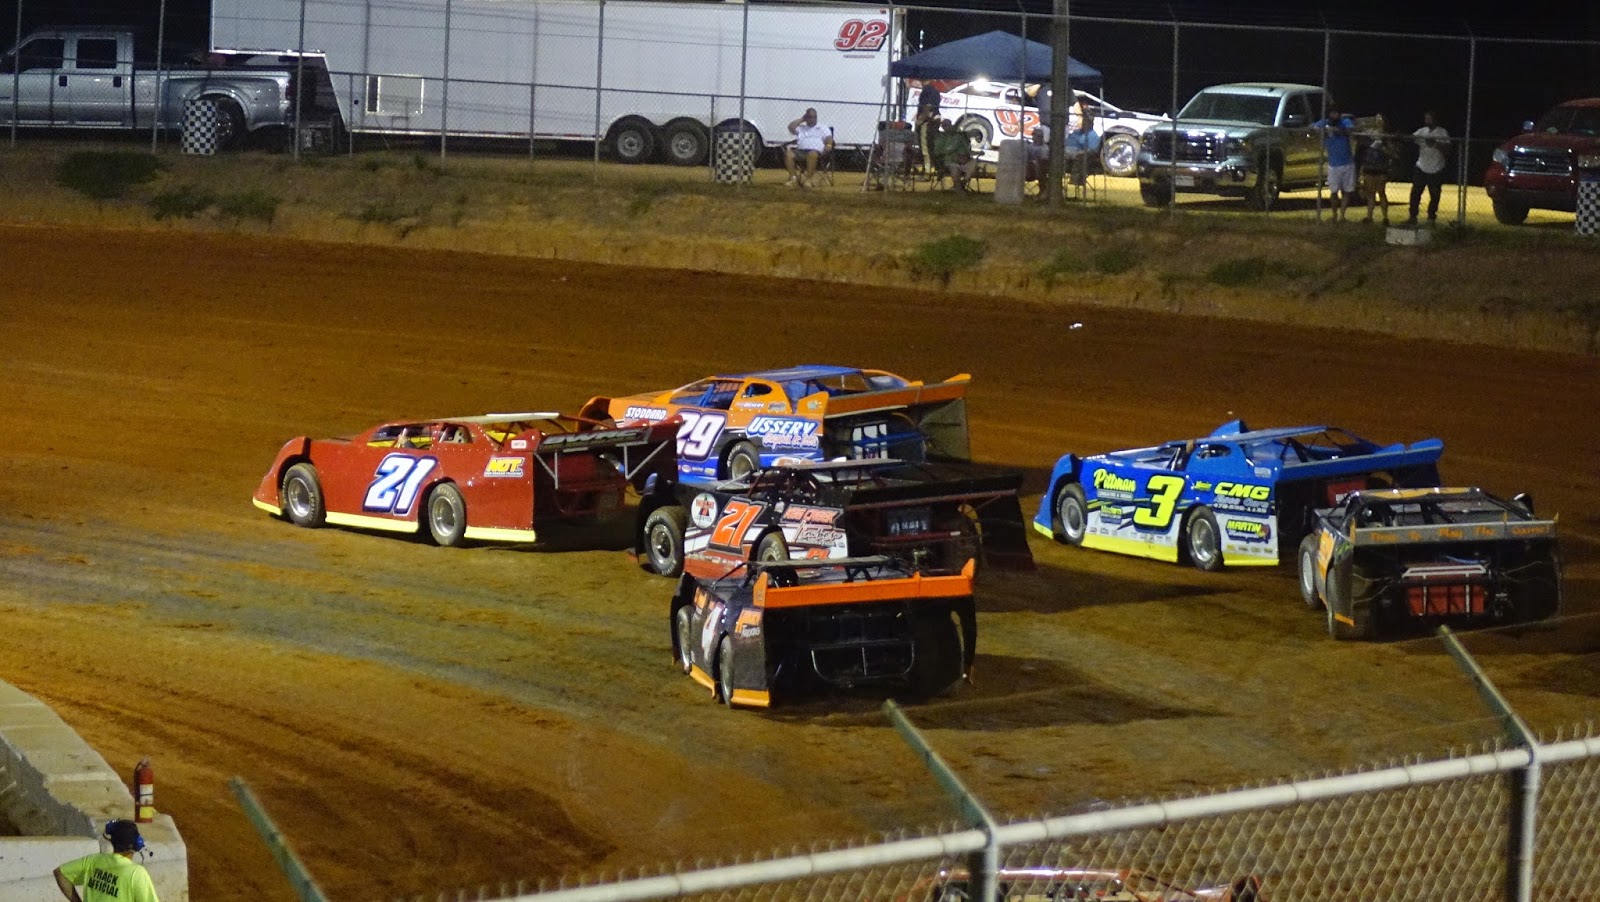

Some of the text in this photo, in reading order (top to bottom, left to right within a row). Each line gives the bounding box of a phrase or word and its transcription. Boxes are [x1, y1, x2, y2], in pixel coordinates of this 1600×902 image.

[834, 18, 889, 51] 92
[994, 106, 1040, 138] 92
[625, 407, 667, 420] STODDARD
[747, 416, 816, 437] USSERY
[363, 454, 437, 515] 21
[1093, 468, 1136, 492] Pittman
[1214, 482, 1270, 500] CMG
[1134, 475, 1185, 527] 3
[709, 499, 763, 550] 21
[1226, 520, 1263, 534] MARTIN
[93, 868, 119, 885] TRACK
[88, 878, 119, 898] OFFICIAL
